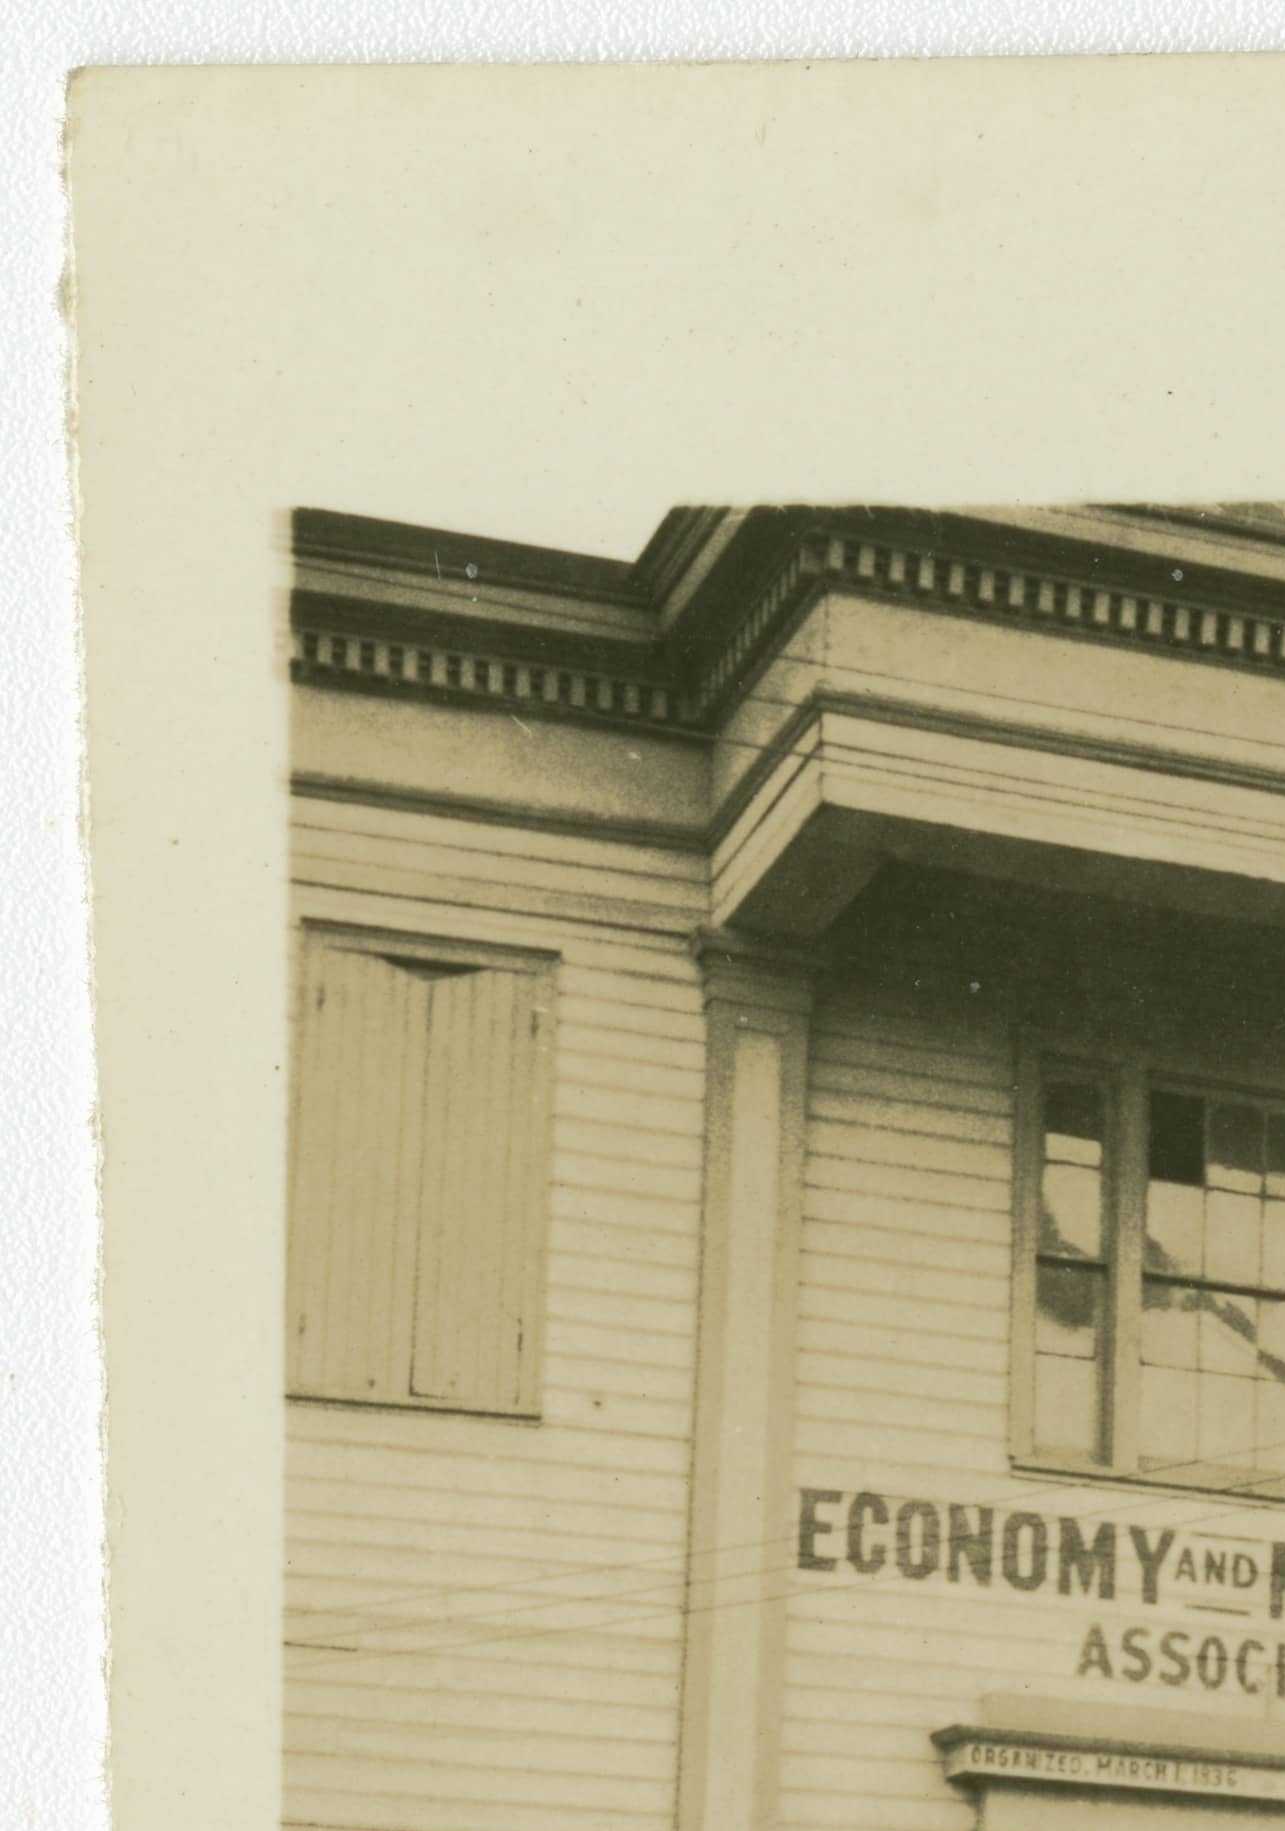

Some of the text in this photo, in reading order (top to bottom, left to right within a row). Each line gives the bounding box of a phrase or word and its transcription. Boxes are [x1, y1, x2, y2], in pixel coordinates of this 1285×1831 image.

[797, 1487, 1175, 1604] ECONOMY
[1174, 1547, 1258, 1588] AND
[1096, 1755, 1167, 1782] MARCH
